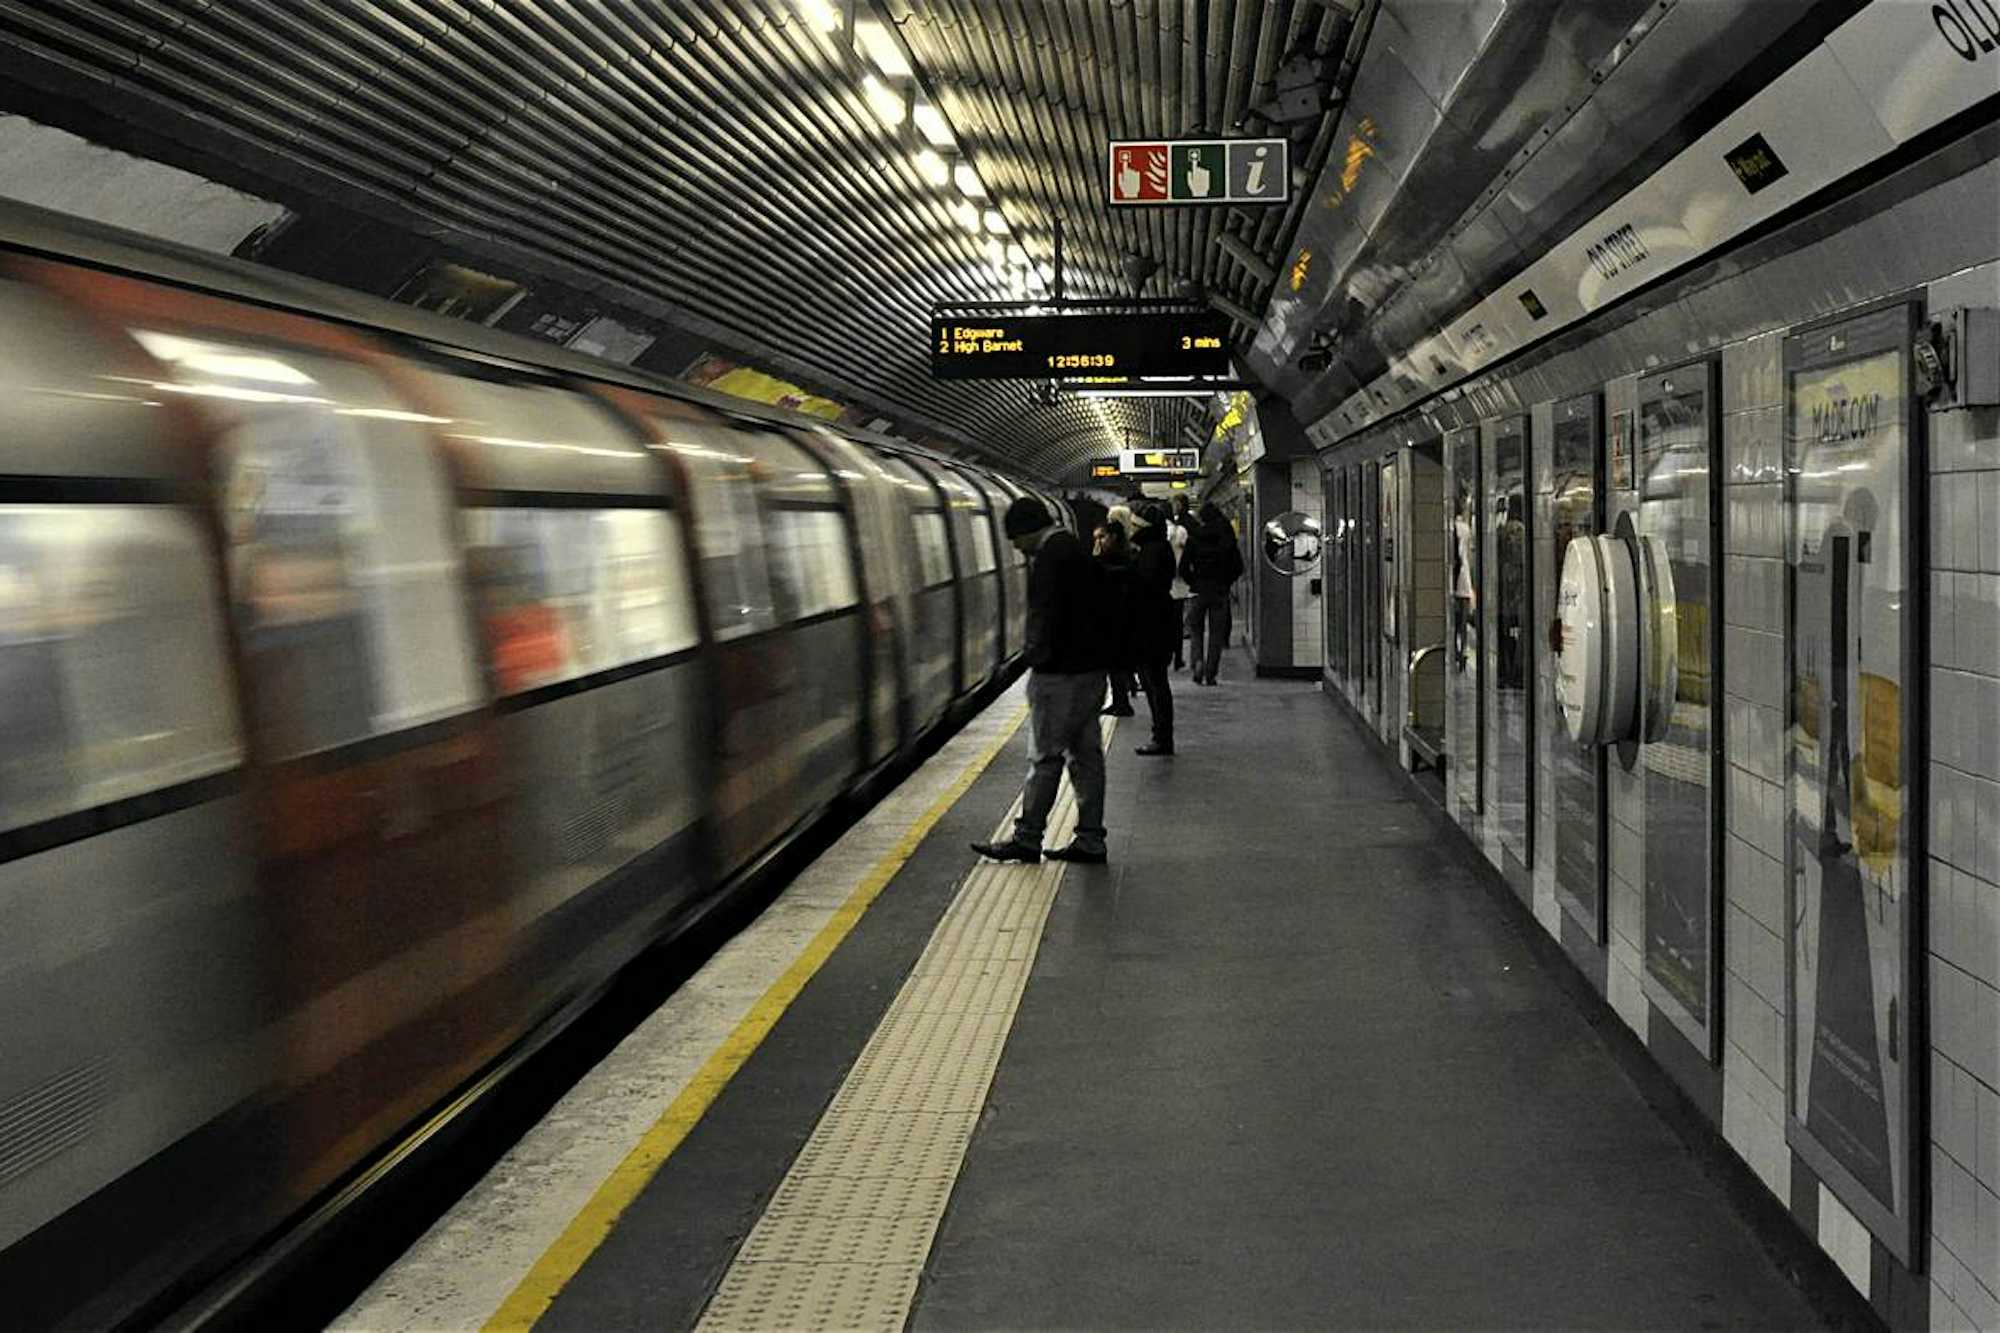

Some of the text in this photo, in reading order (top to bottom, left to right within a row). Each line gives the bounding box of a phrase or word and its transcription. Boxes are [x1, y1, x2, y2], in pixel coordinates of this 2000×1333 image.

[941, 327, 1004, 340] 1 Edgware
[939, 336, 1221, 354] 2 High Barnet 3 mins
[1047, 354, 1115, 368] 12:56:39
